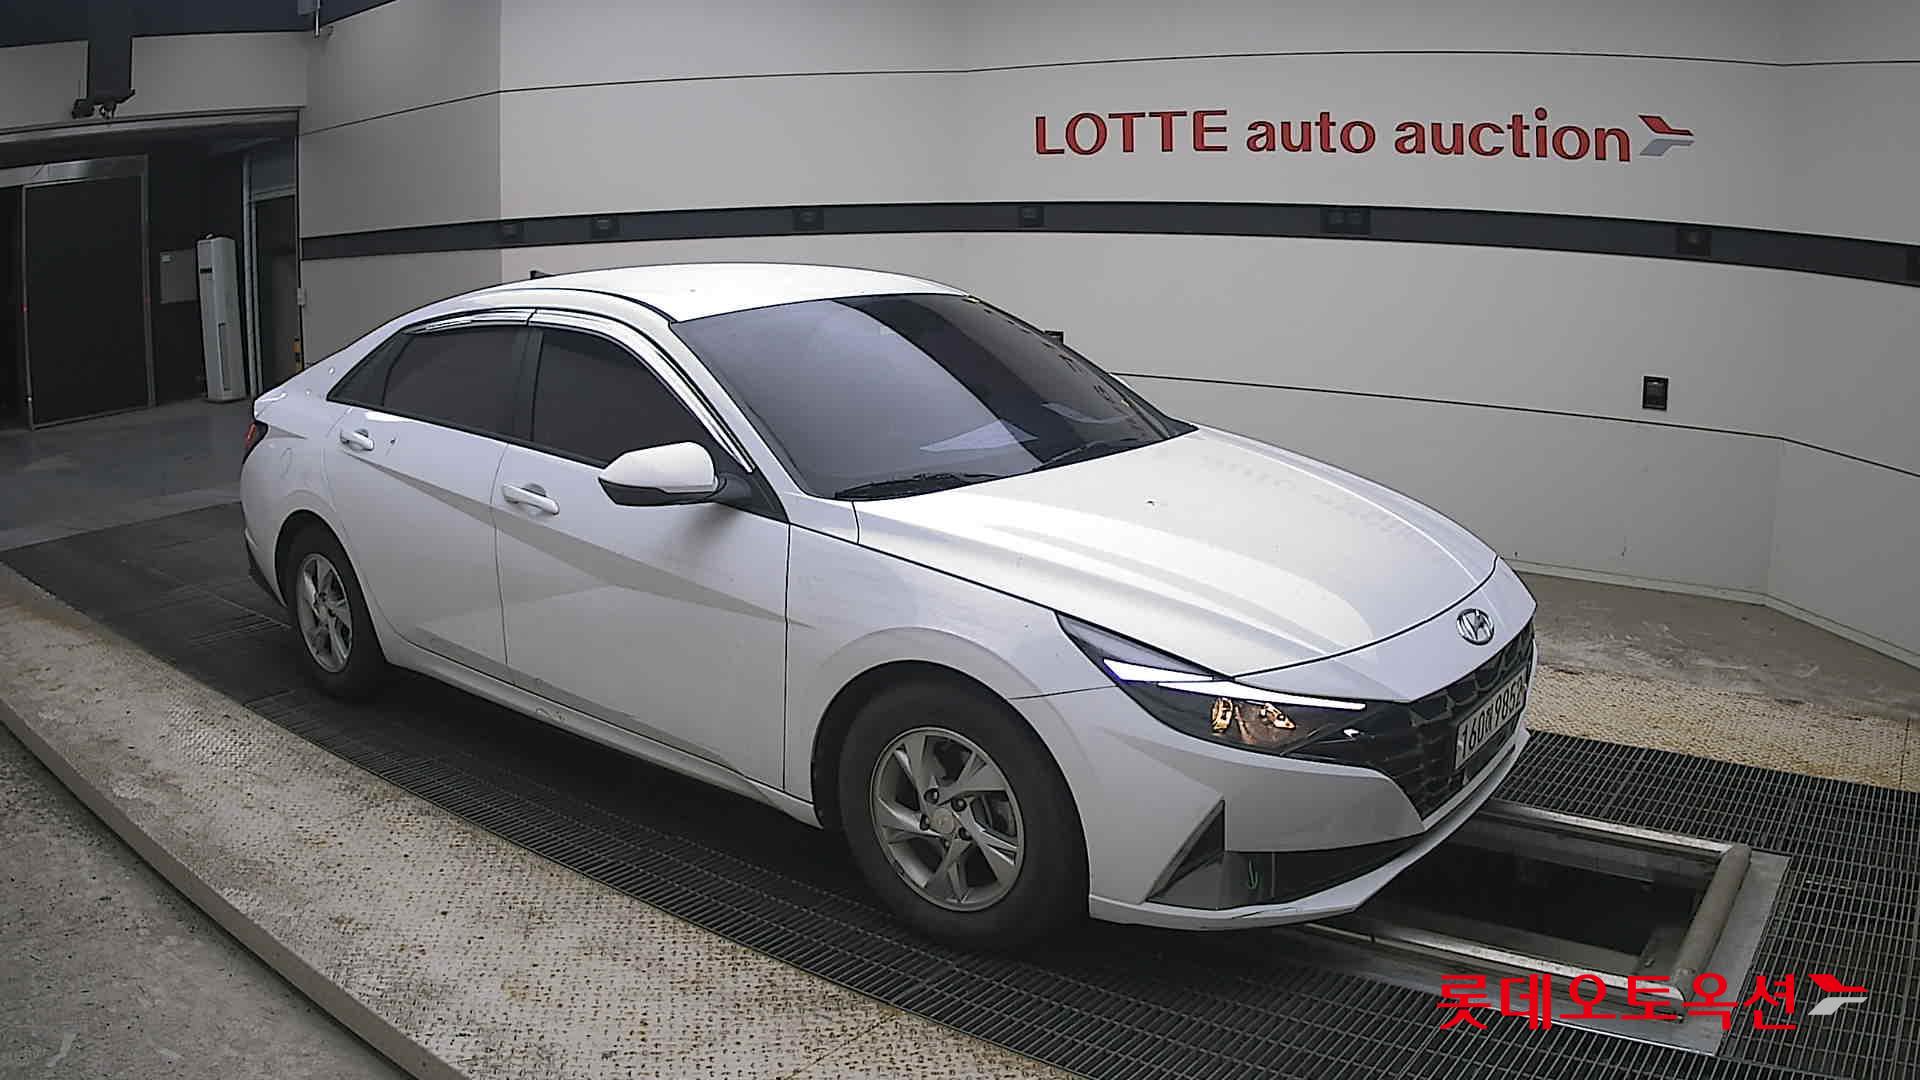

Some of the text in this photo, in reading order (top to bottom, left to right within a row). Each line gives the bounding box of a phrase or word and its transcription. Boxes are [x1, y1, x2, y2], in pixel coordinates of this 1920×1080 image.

[1035, 107, 1633, 162] LOTTE auto auction
